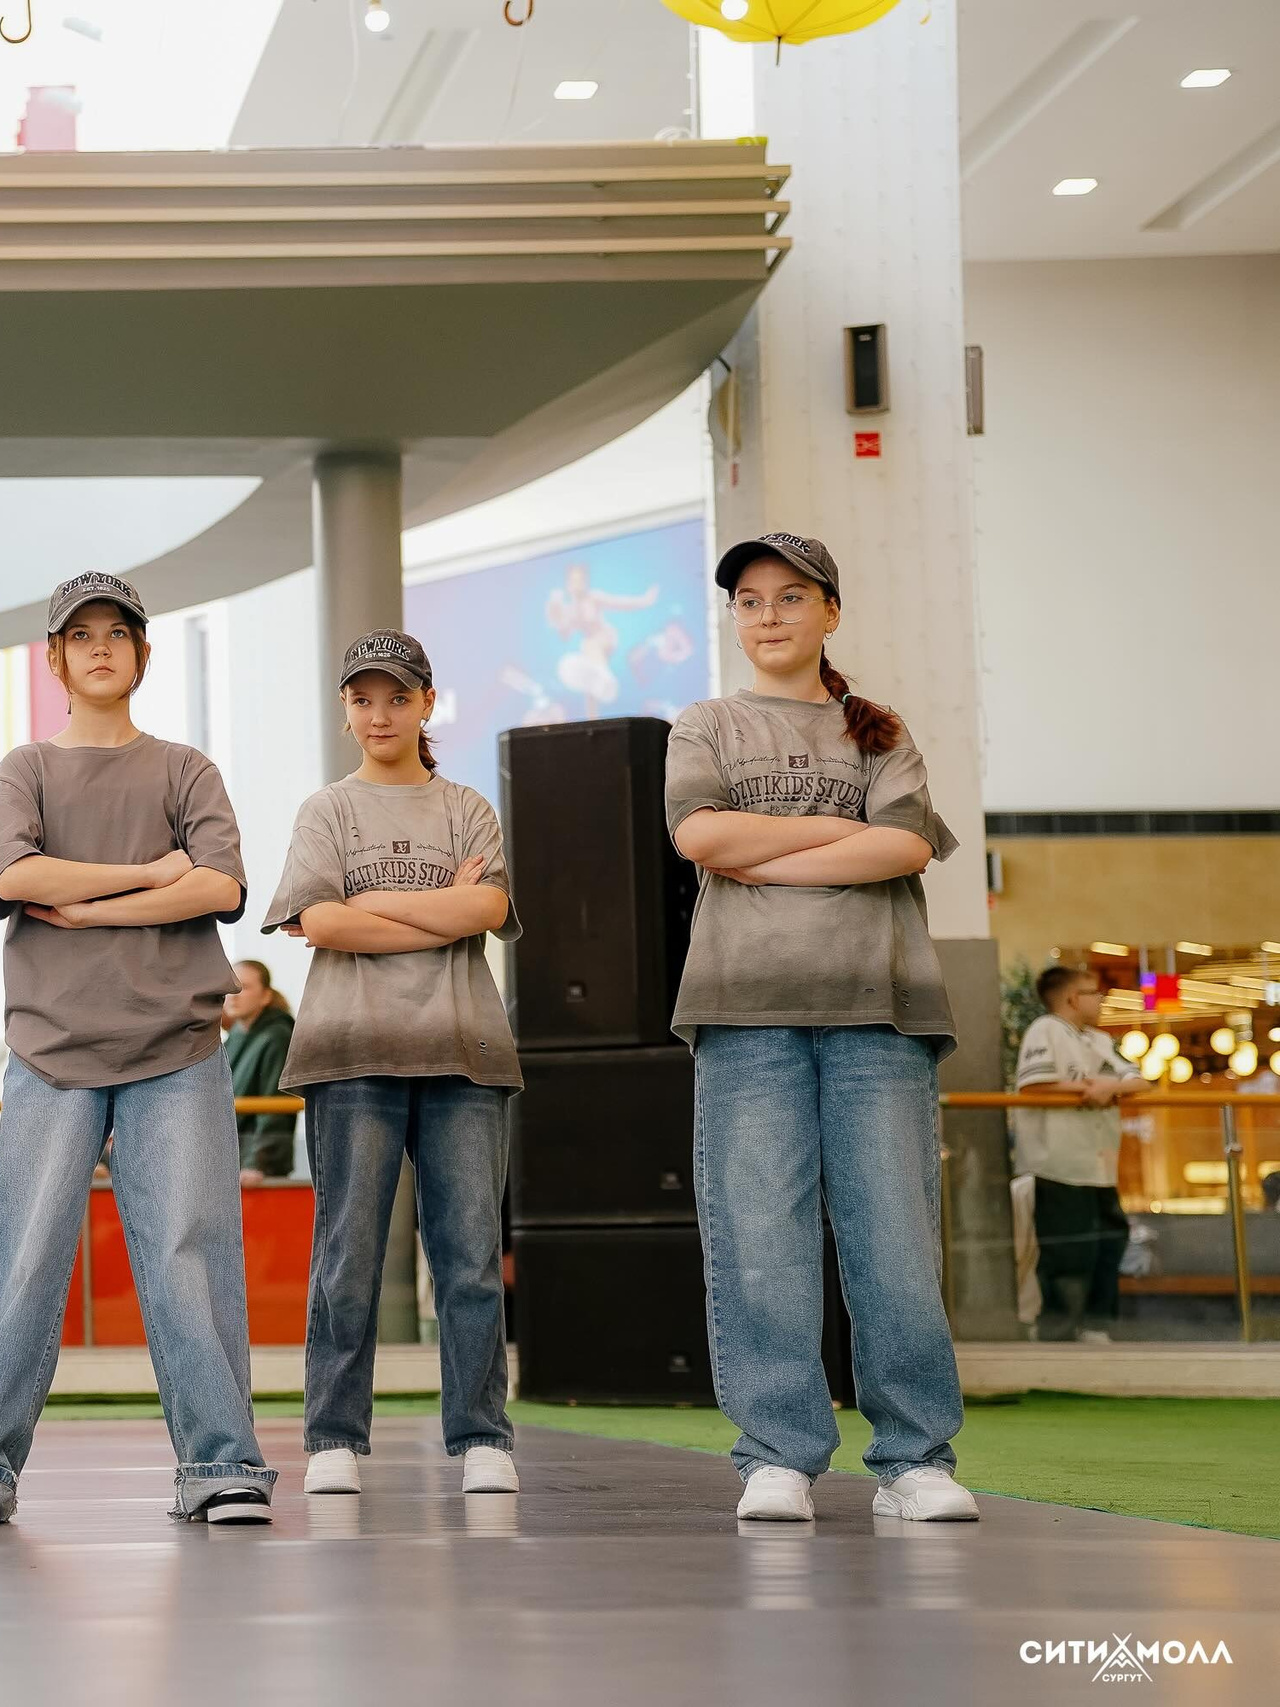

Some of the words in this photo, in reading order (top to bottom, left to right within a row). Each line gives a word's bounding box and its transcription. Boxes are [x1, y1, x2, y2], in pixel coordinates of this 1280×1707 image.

[96, 573, 133, 600] YORK
[350, 638, 376, 662] NEW
[376, 636, 410, 661] YORK
